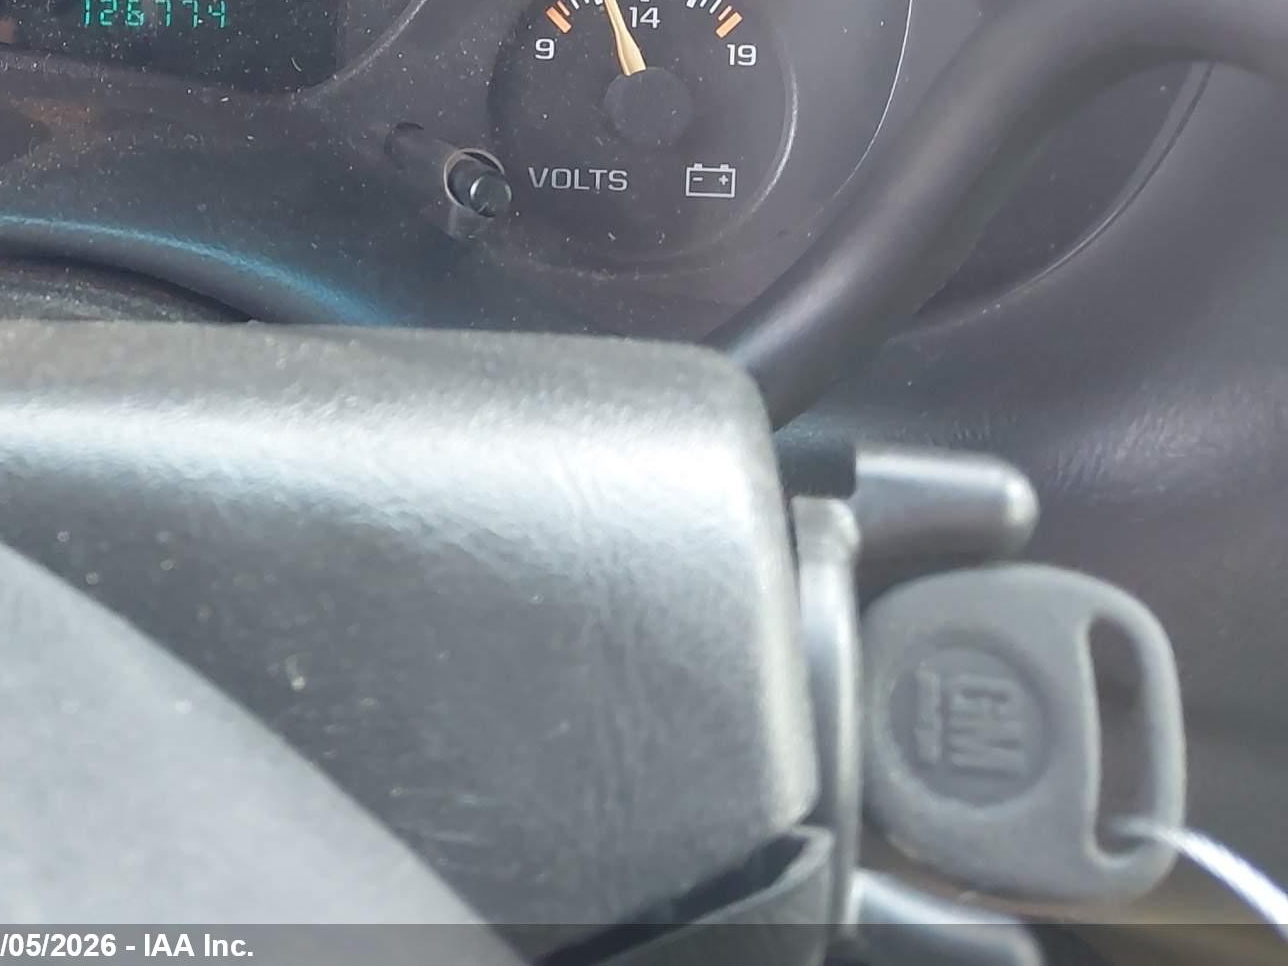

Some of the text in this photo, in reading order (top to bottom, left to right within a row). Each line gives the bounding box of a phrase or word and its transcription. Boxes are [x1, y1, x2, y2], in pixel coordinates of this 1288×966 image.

[629, 6, 661, 28] 14
[535, 38, 556, 60] 9
[727, 44, 757, 66] 19
[528, 167, 628, 191] VOLTS
